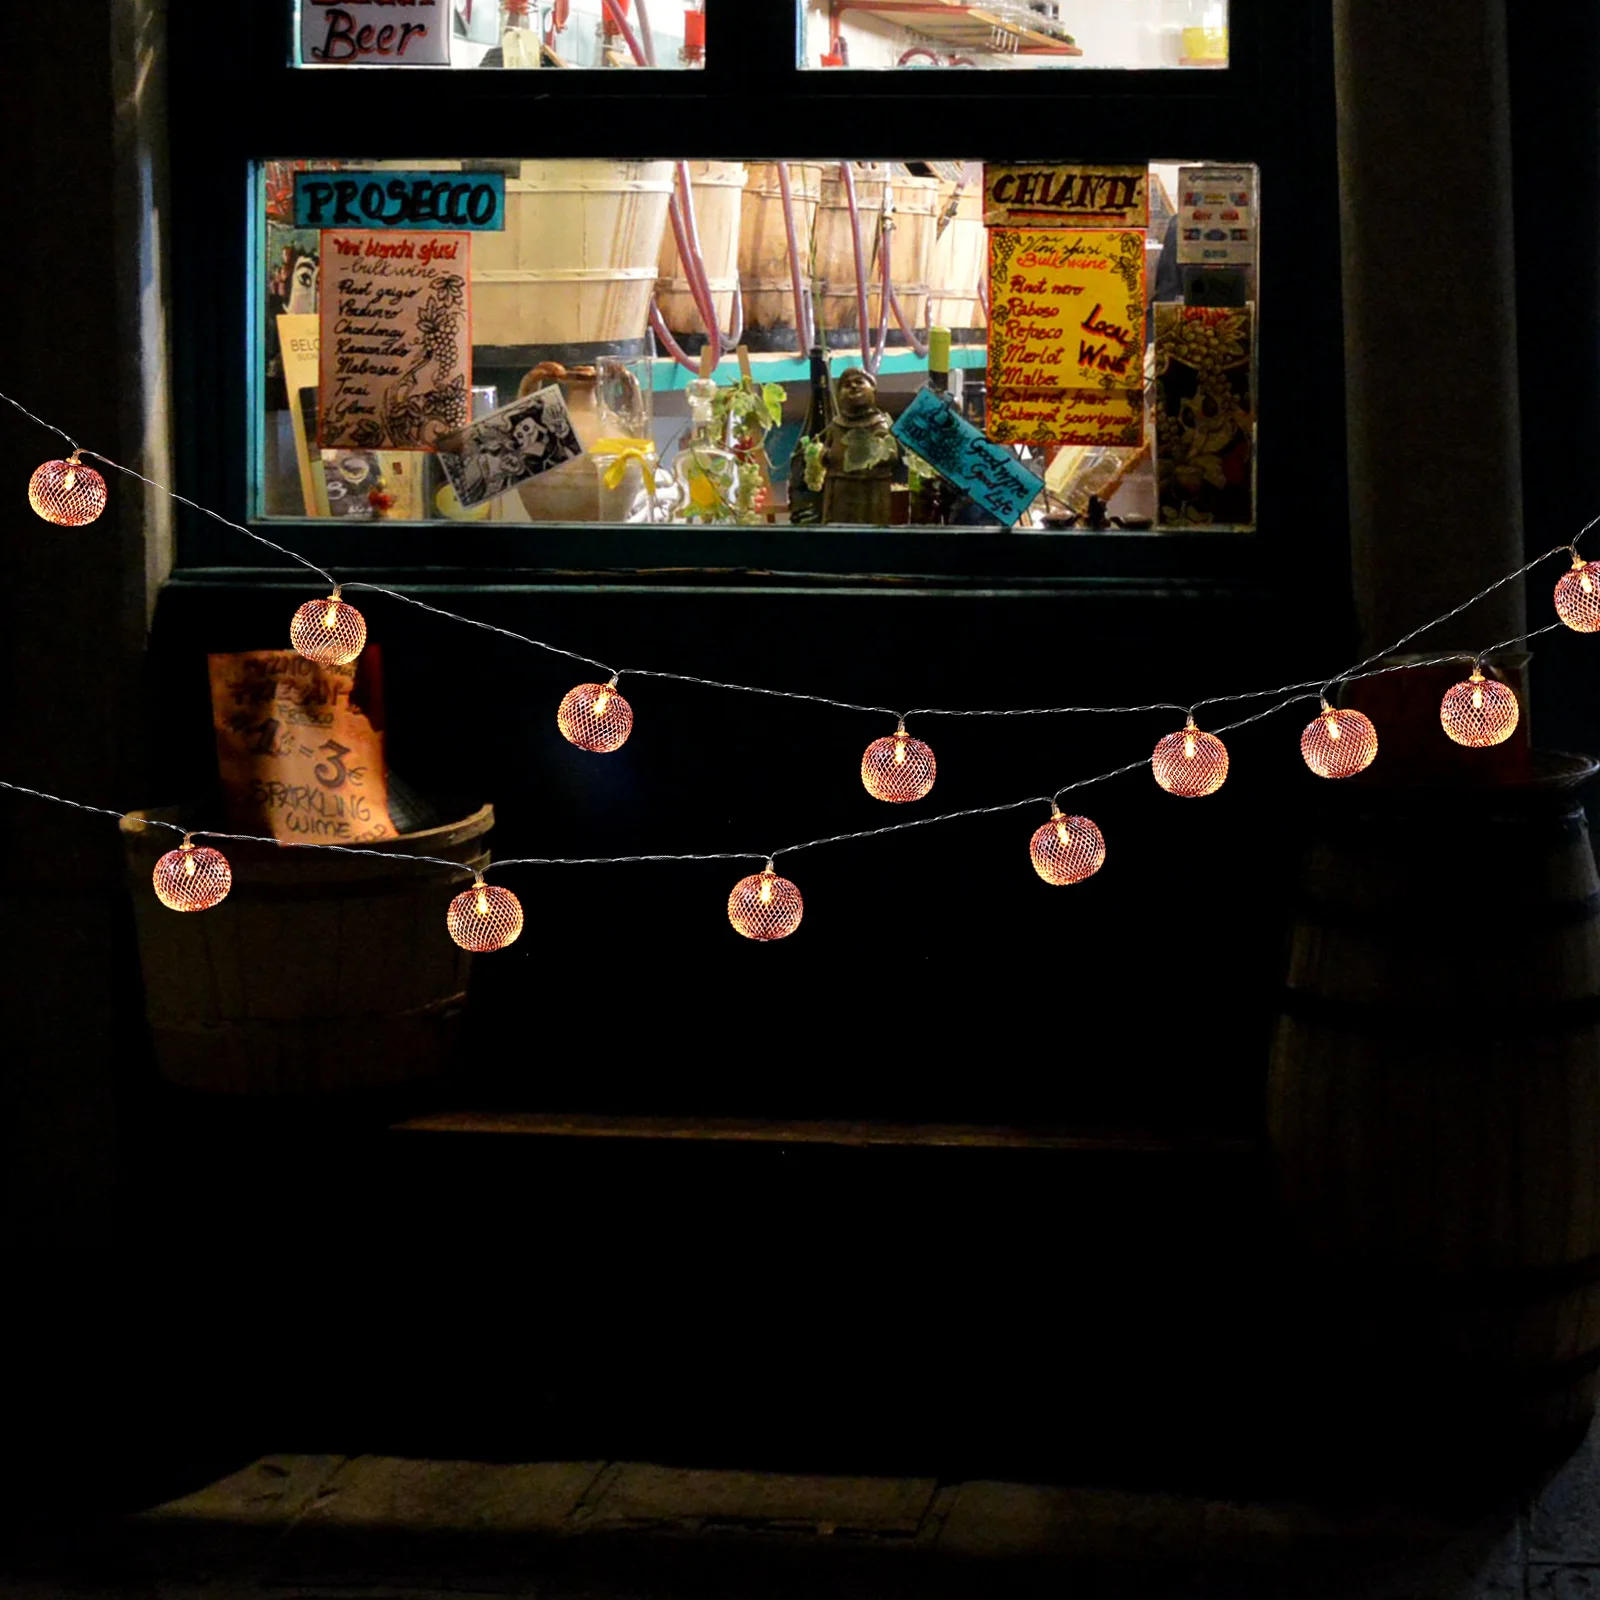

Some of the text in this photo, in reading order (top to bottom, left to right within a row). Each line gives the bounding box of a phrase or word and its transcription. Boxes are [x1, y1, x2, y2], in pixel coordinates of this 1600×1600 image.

[312, 8, 426, 62] Beer
[302, 180, 496, 226] PROSECCO
[992, 172, 1142, 210] CHIANTI
[365, 237, 414, 261] bianchi
[417, 238, 459, 266] sfusi
[1067, 255, 1108, 270] wine
[338, 278, 422, 306] Pinot grigio
[1009, 274, 1085, 296] Pinot nero
[1007, 297, 1060, 318] Raboso
[1005, 319, 1063, 344] Refosco
[1002, 343, 1066, 365] Merlot
[1001, 366, 1059, 386] Malbec
[1000, 387, 1067, 405] Cabernet
[998, 403, 1062, 423] Cabernet
[965, 436, 1011, 472] Good
[250, 778, 371, 822] SPARKLING
